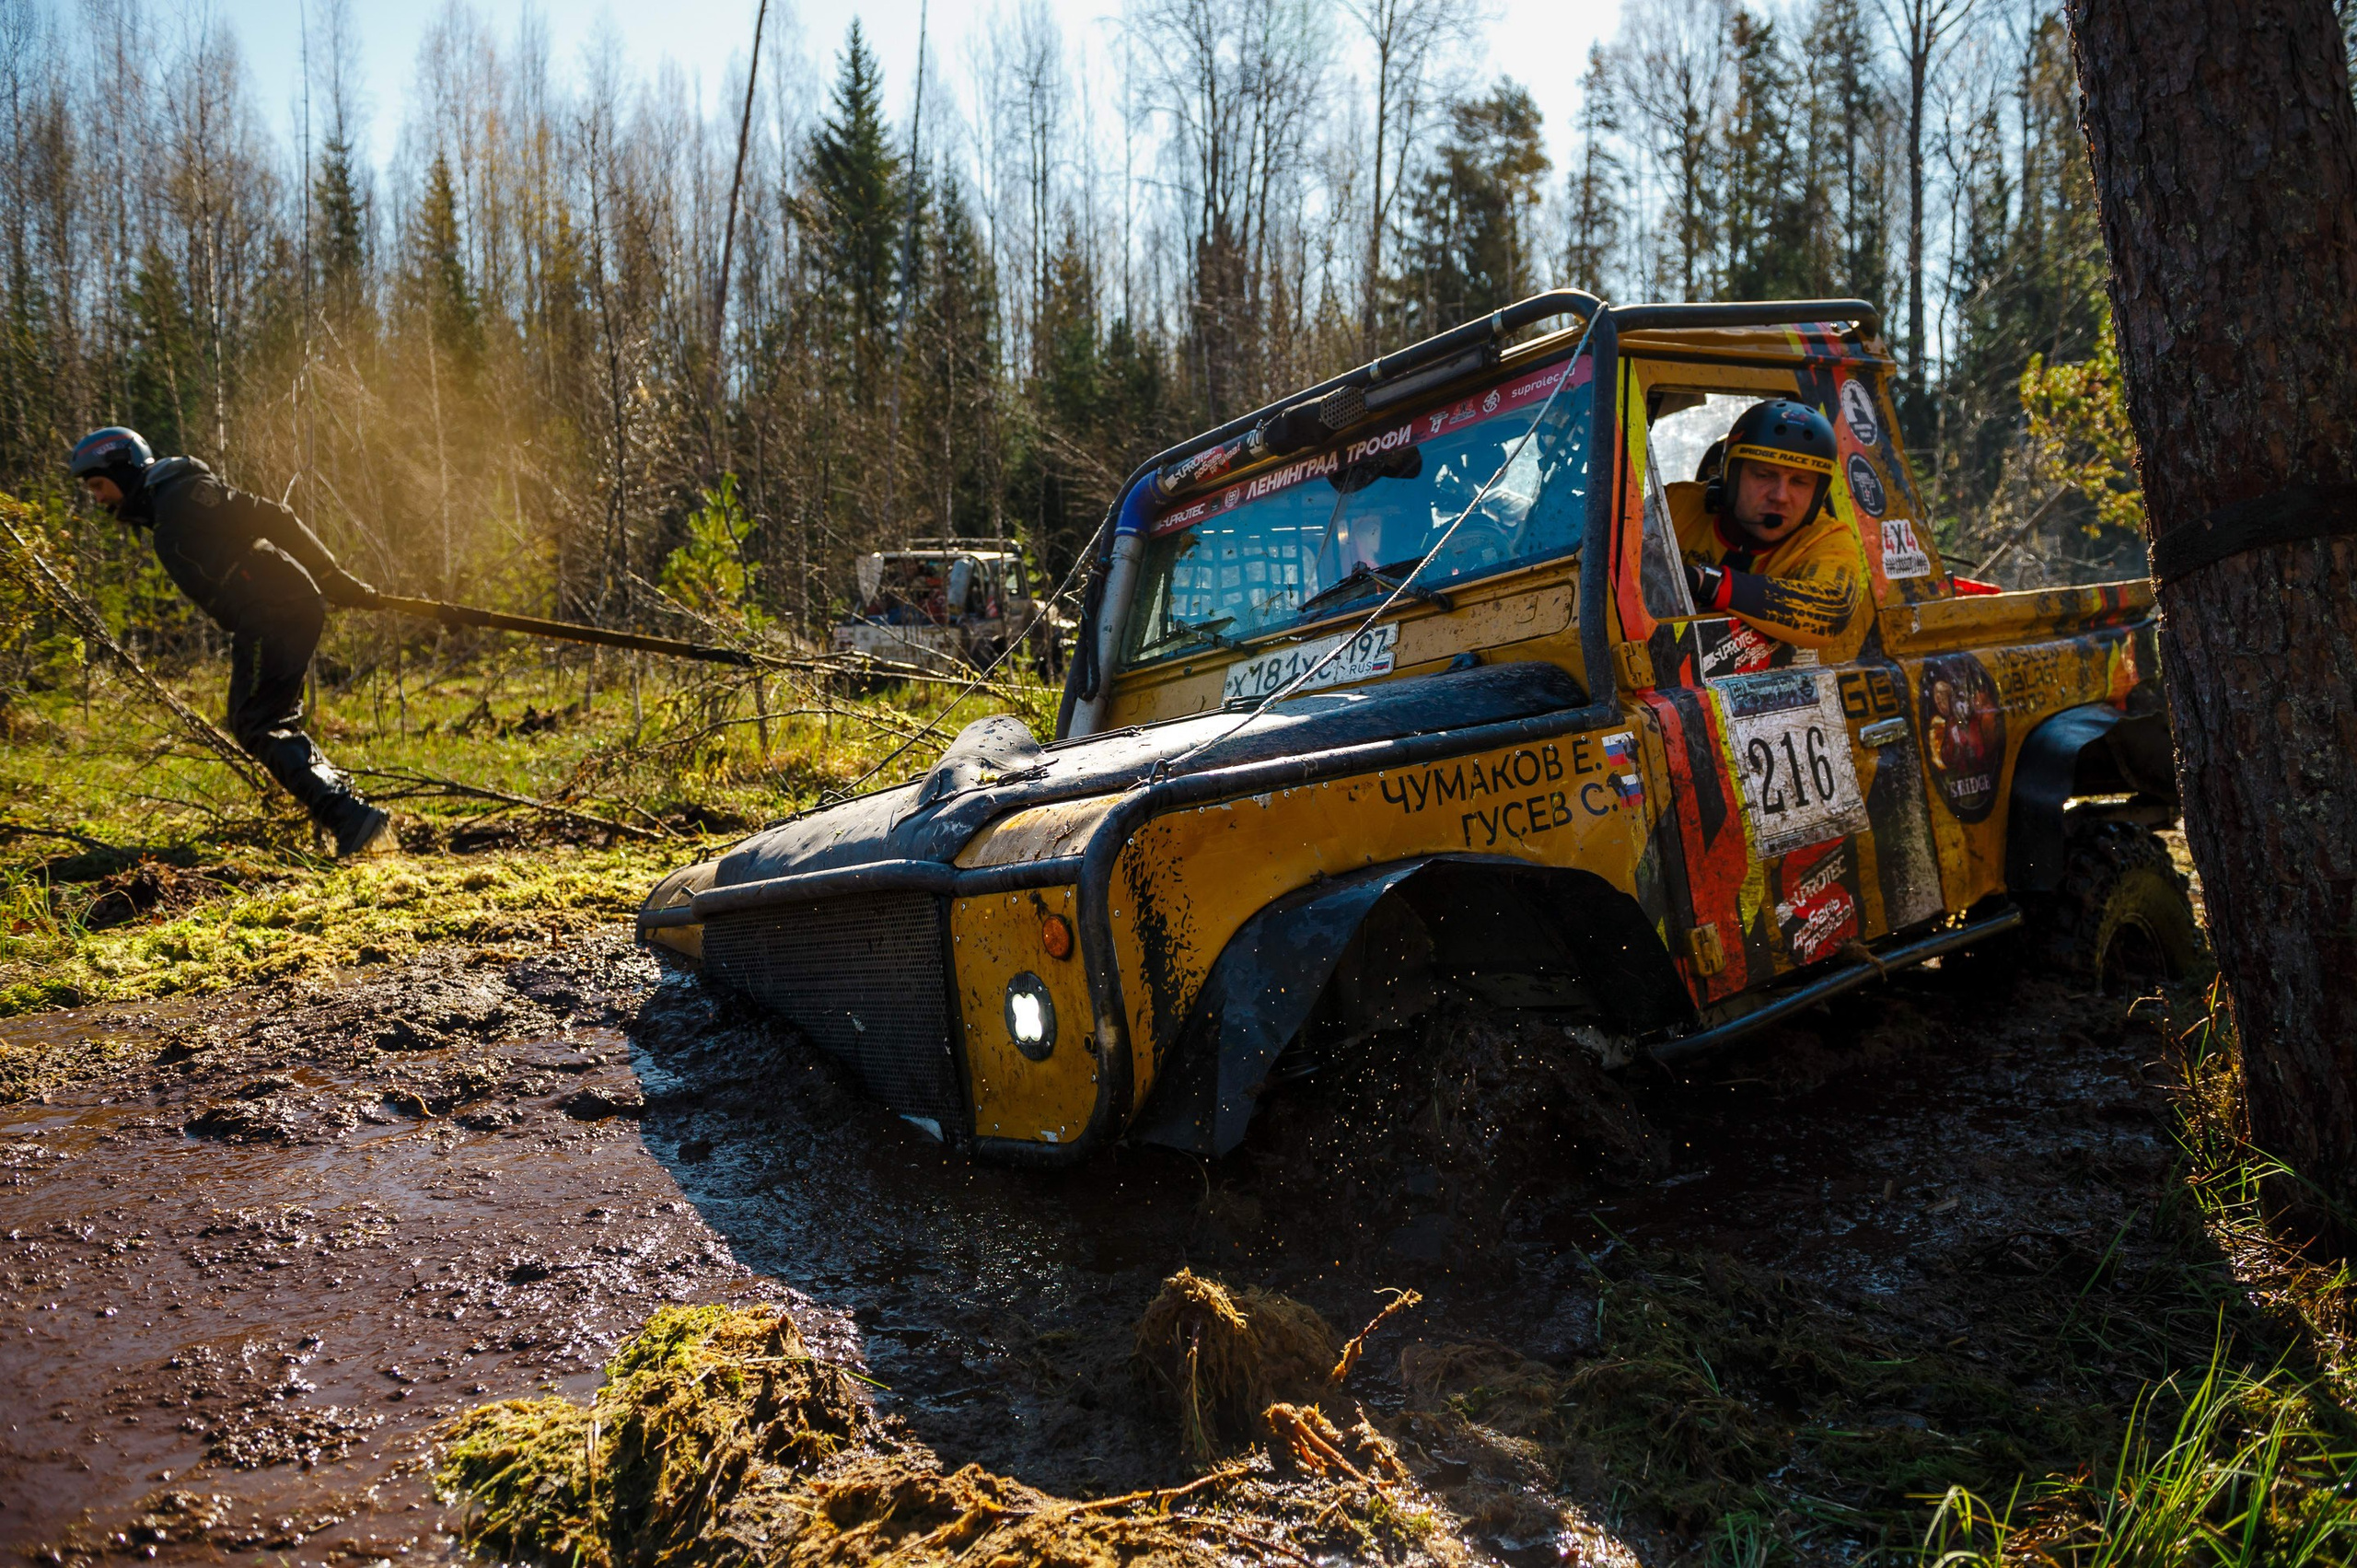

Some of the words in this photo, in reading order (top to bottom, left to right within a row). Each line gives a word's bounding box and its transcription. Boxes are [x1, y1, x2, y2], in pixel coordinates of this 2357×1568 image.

[1246, 451, 1339, 500] ЛЕНИНГРАД
[1347, 424, 1412, 463] ТРОФИ
[1778, 453, 1809, 465] RACE
[1348, 628, 1388, 664] 197
[1349, 660, 1373, 675] RUS
[1380, 746, 1563, 814] ЧУМАКОВ
[1747, 726, 1835, 816] 216
[1461, 791, 1573, 849] ГУСЕВ
